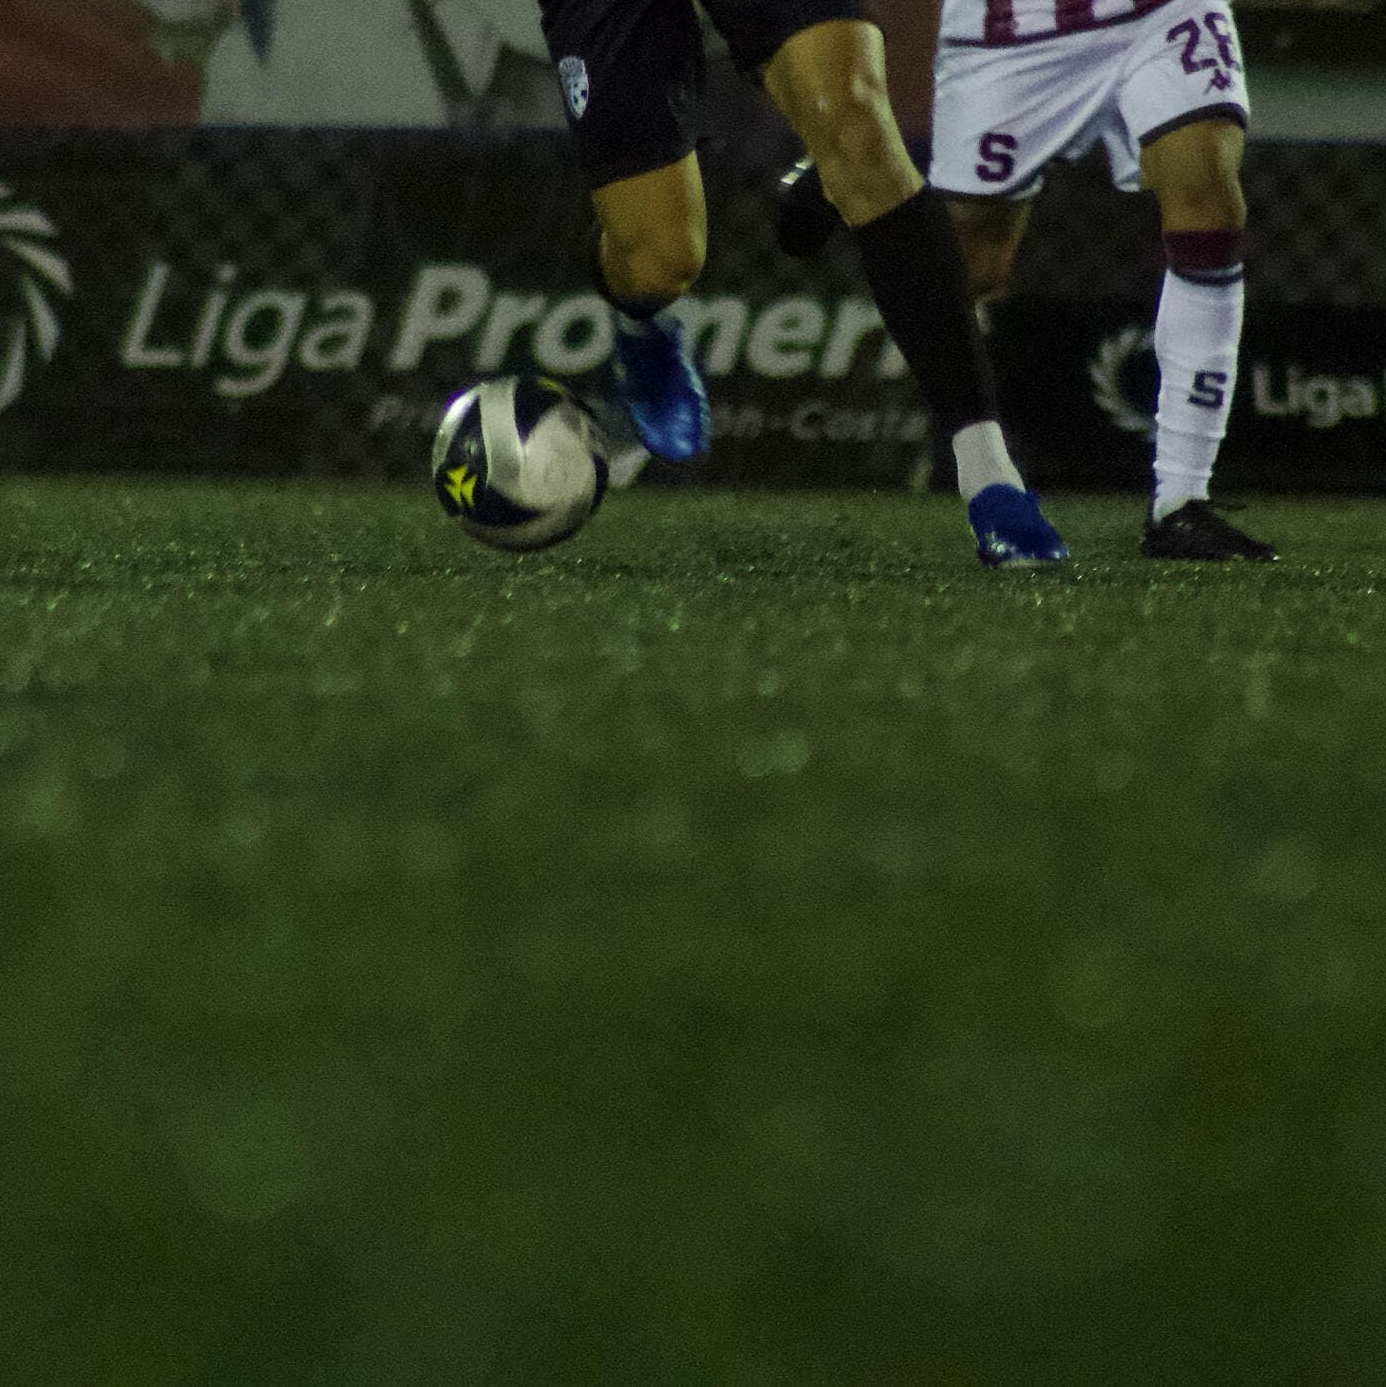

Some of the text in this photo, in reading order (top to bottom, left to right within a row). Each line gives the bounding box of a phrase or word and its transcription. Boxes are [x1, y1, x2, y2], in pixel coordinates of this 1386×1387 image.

[976, 132, 1017, 182] S
[123, 261, 378, 398] Liga
[1252, 363, 1381, 430] Liga
